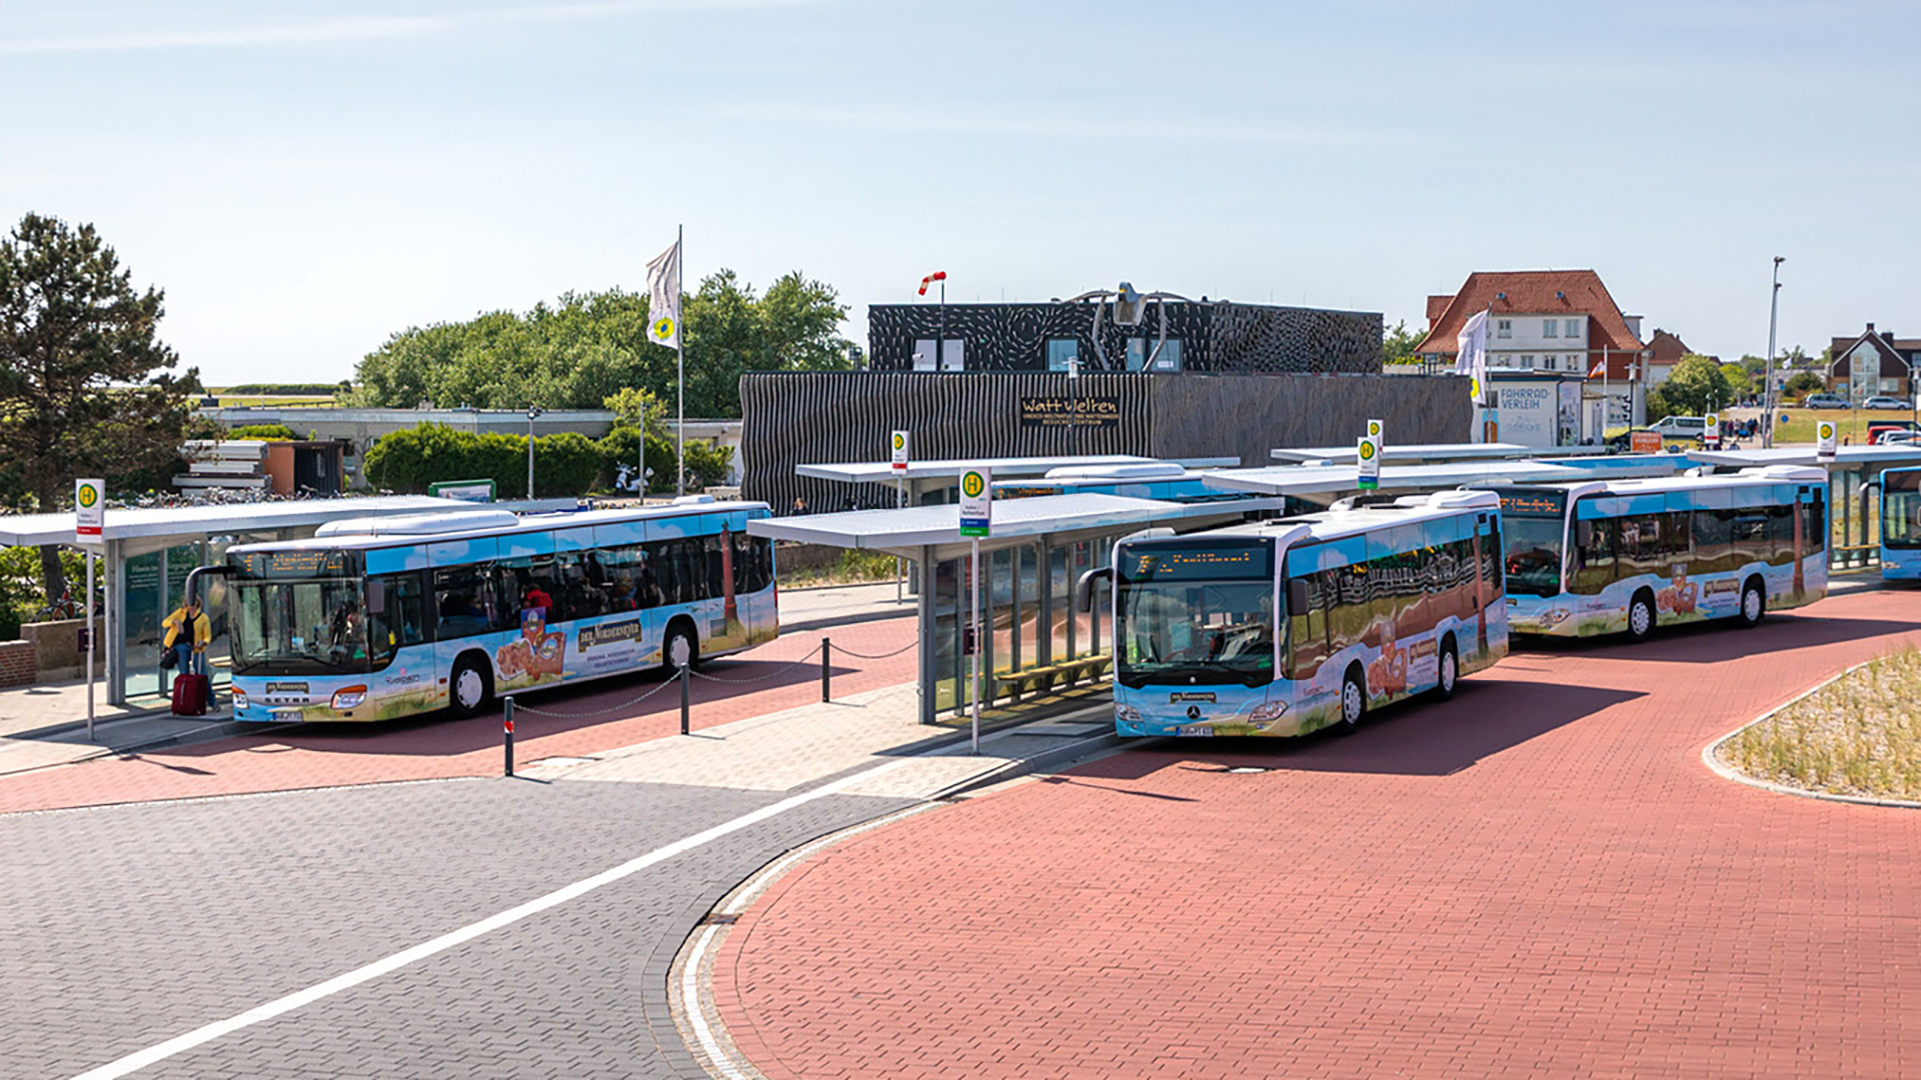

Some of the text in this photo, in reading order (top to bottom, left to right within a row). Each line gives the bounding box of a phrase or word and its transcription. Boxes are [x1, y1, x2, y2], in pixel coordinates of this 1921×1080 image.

[1501, 388, 1551, 399] FAHRRAD-
[1022, 398, 1062, 412] Watt
[1502, 399, 1540, 410] VERLEIH
